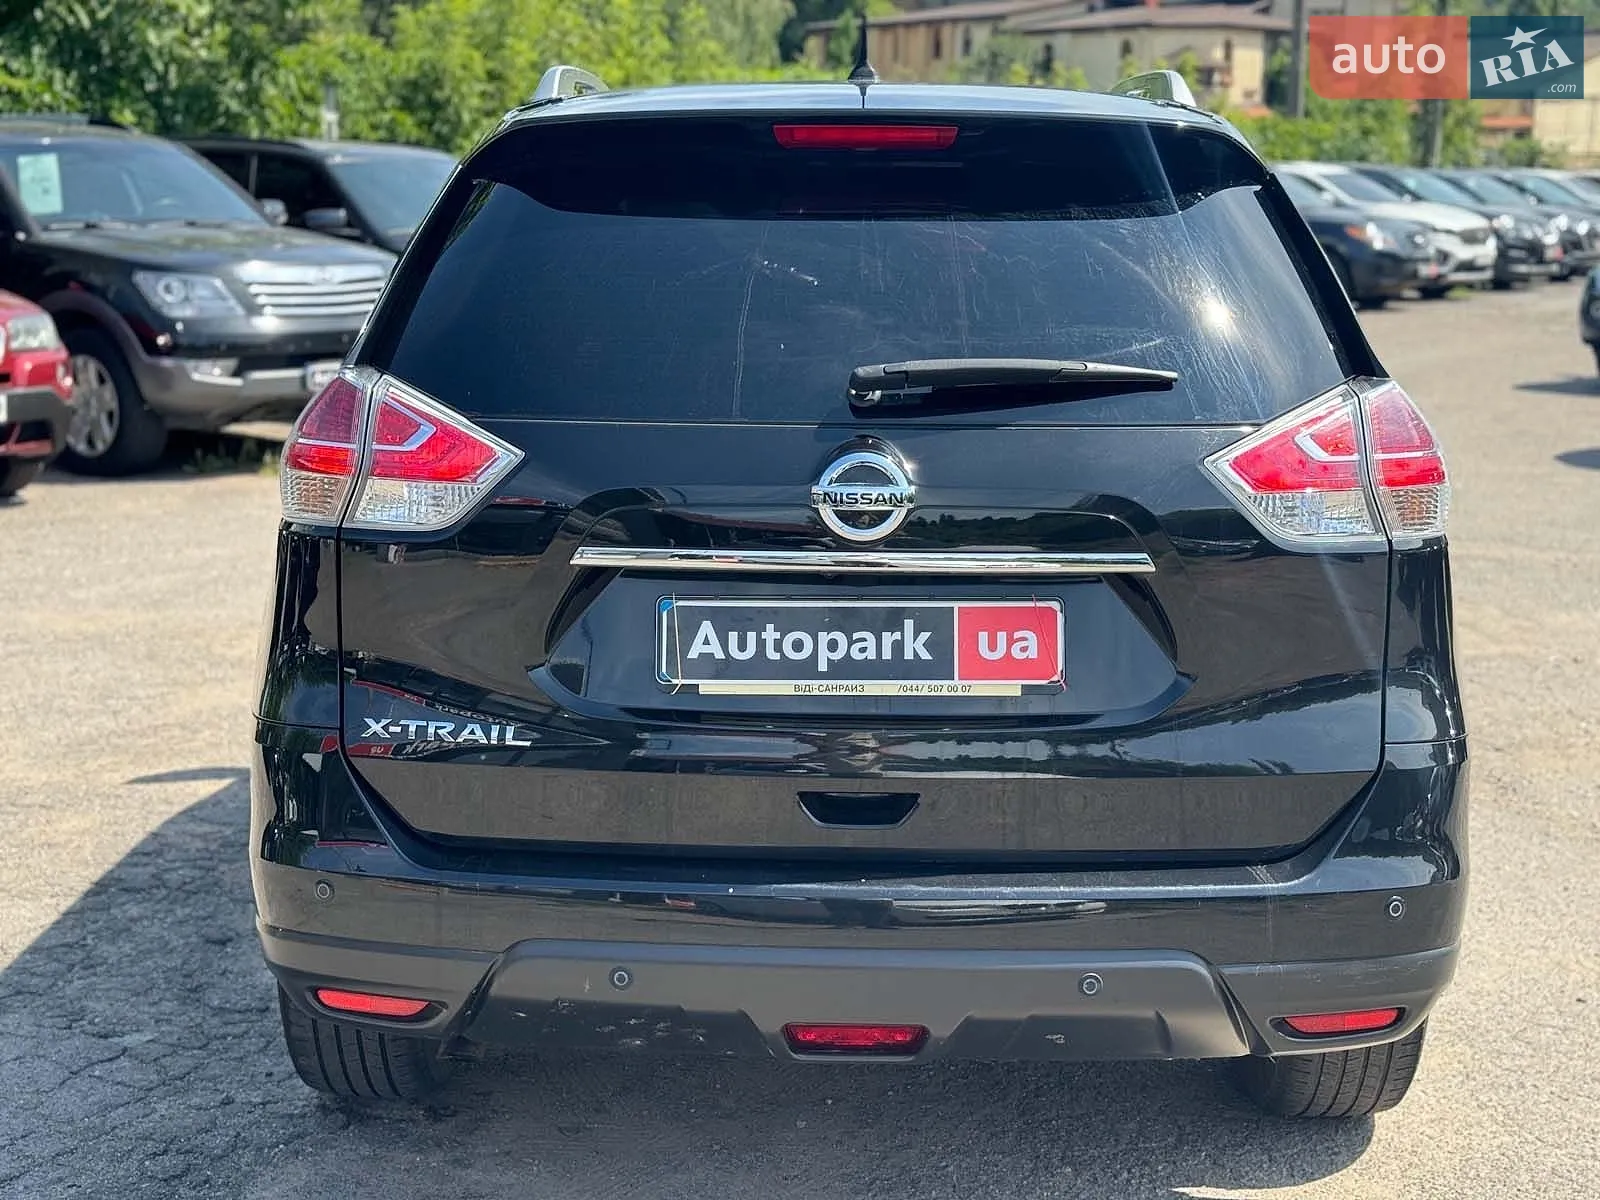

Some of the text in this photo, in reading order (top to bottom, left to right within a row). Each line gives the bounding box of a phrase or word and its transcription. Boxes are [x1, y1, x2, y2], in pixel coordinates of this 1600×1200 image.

[822, 491, 905, 506] NISSAN
[686, 618, 1039, 672] Autopark ua
[927, 684, 944, 693] 507
[947, 684, 959, 693] 00
[961, 684, 972, 693] 07
[360, 717, 532, 748] X-TRAIL
